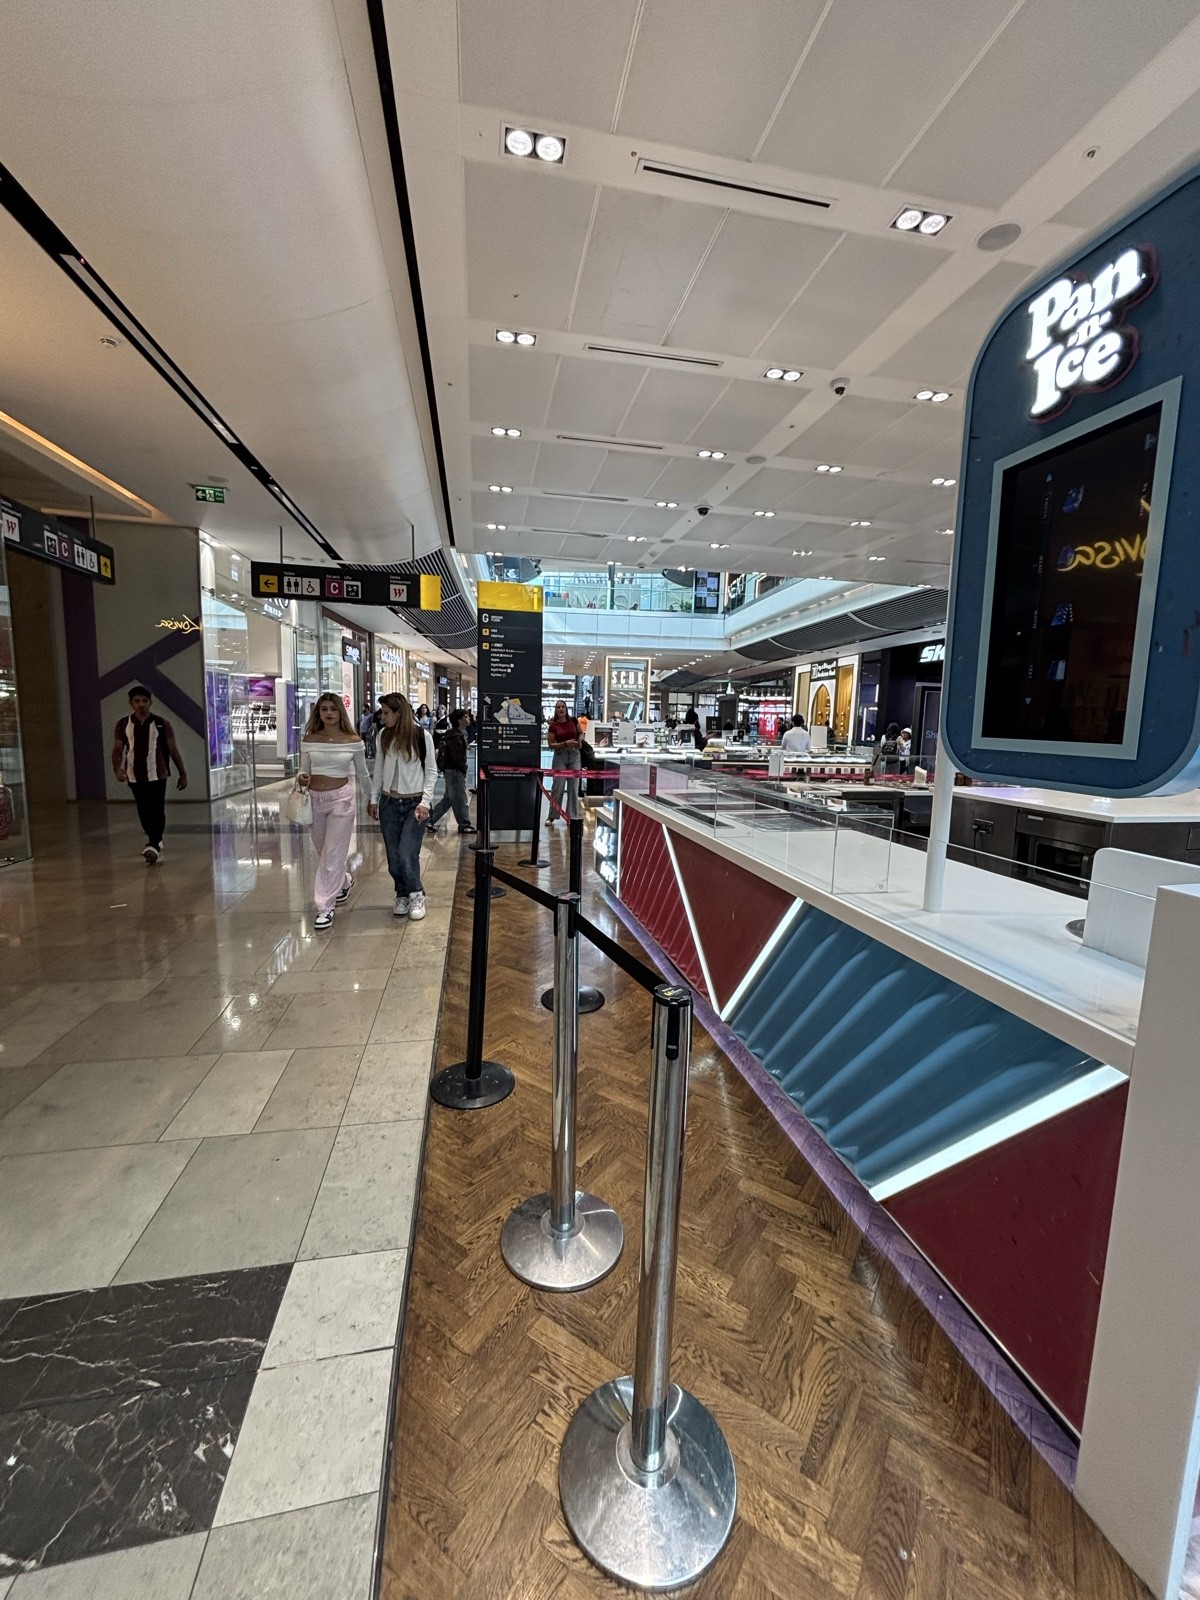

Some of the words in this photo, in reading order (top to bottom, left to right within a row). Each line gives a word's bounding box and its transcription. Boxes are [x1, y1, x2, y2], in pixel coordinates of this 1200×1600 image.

[1025, 247, 1147, 361] Pan
[1029, 331, 1122, 416] Ice
[61, 542, 69, 557] C
[330, 582, 339, 594] C
[482, 613, 489, 623] G
